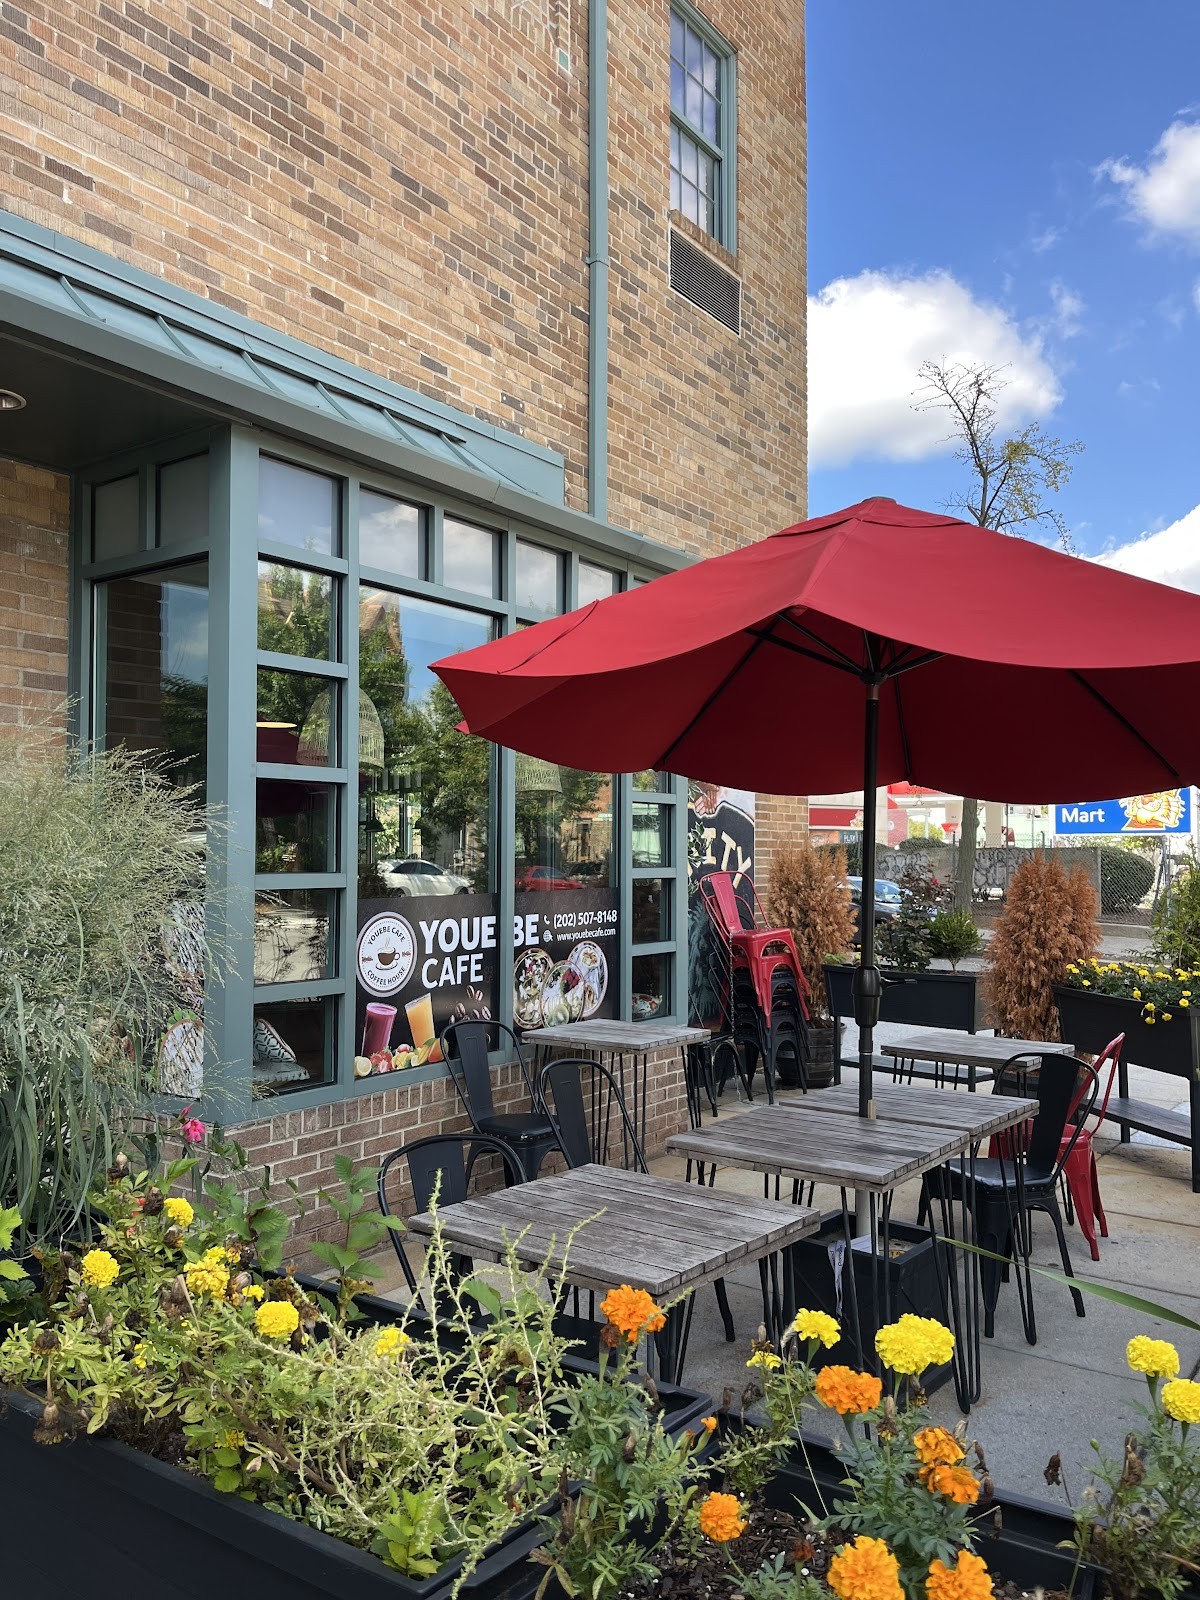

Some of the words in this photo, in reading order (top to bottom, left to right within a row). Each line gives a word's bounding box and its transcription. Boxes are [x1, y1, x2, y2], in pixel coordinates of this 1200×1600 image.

[1061, 807, 1106, 823] Mart
[688, 827, 752, 889] ITY
[553, 912, 576, 929] (202)
[577, 909, 618, 926] 507-8148
[368, 925, 391, 946] YOUEBE
[391, 927, 406, 943] CAFE
[556, 926, 616, 942] www.youebecafe.com
[367, 969, 387, 986] COFFEE
[387, 966, 406, 985] HOUSE
[421, 952, 484, 989] CAFE
